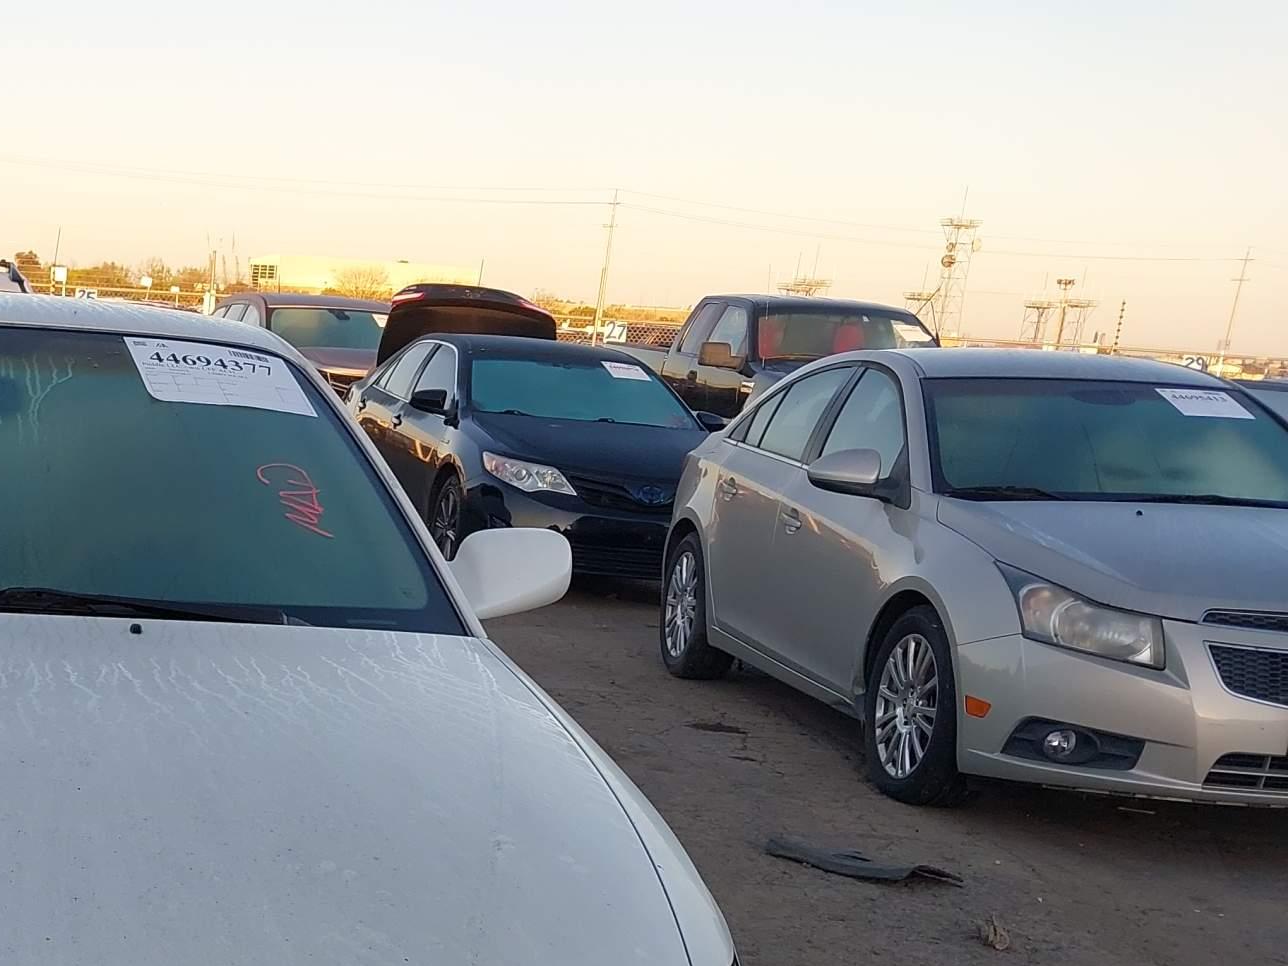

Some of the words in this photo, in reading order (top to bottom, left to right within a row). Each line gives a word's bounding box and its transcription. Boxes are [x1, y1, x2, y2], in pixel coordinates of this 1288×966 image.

[605, 320, 626, 340] 27
[149, 351, 272, 376] 44694377
[1184, 356, 1205, 372] 29
